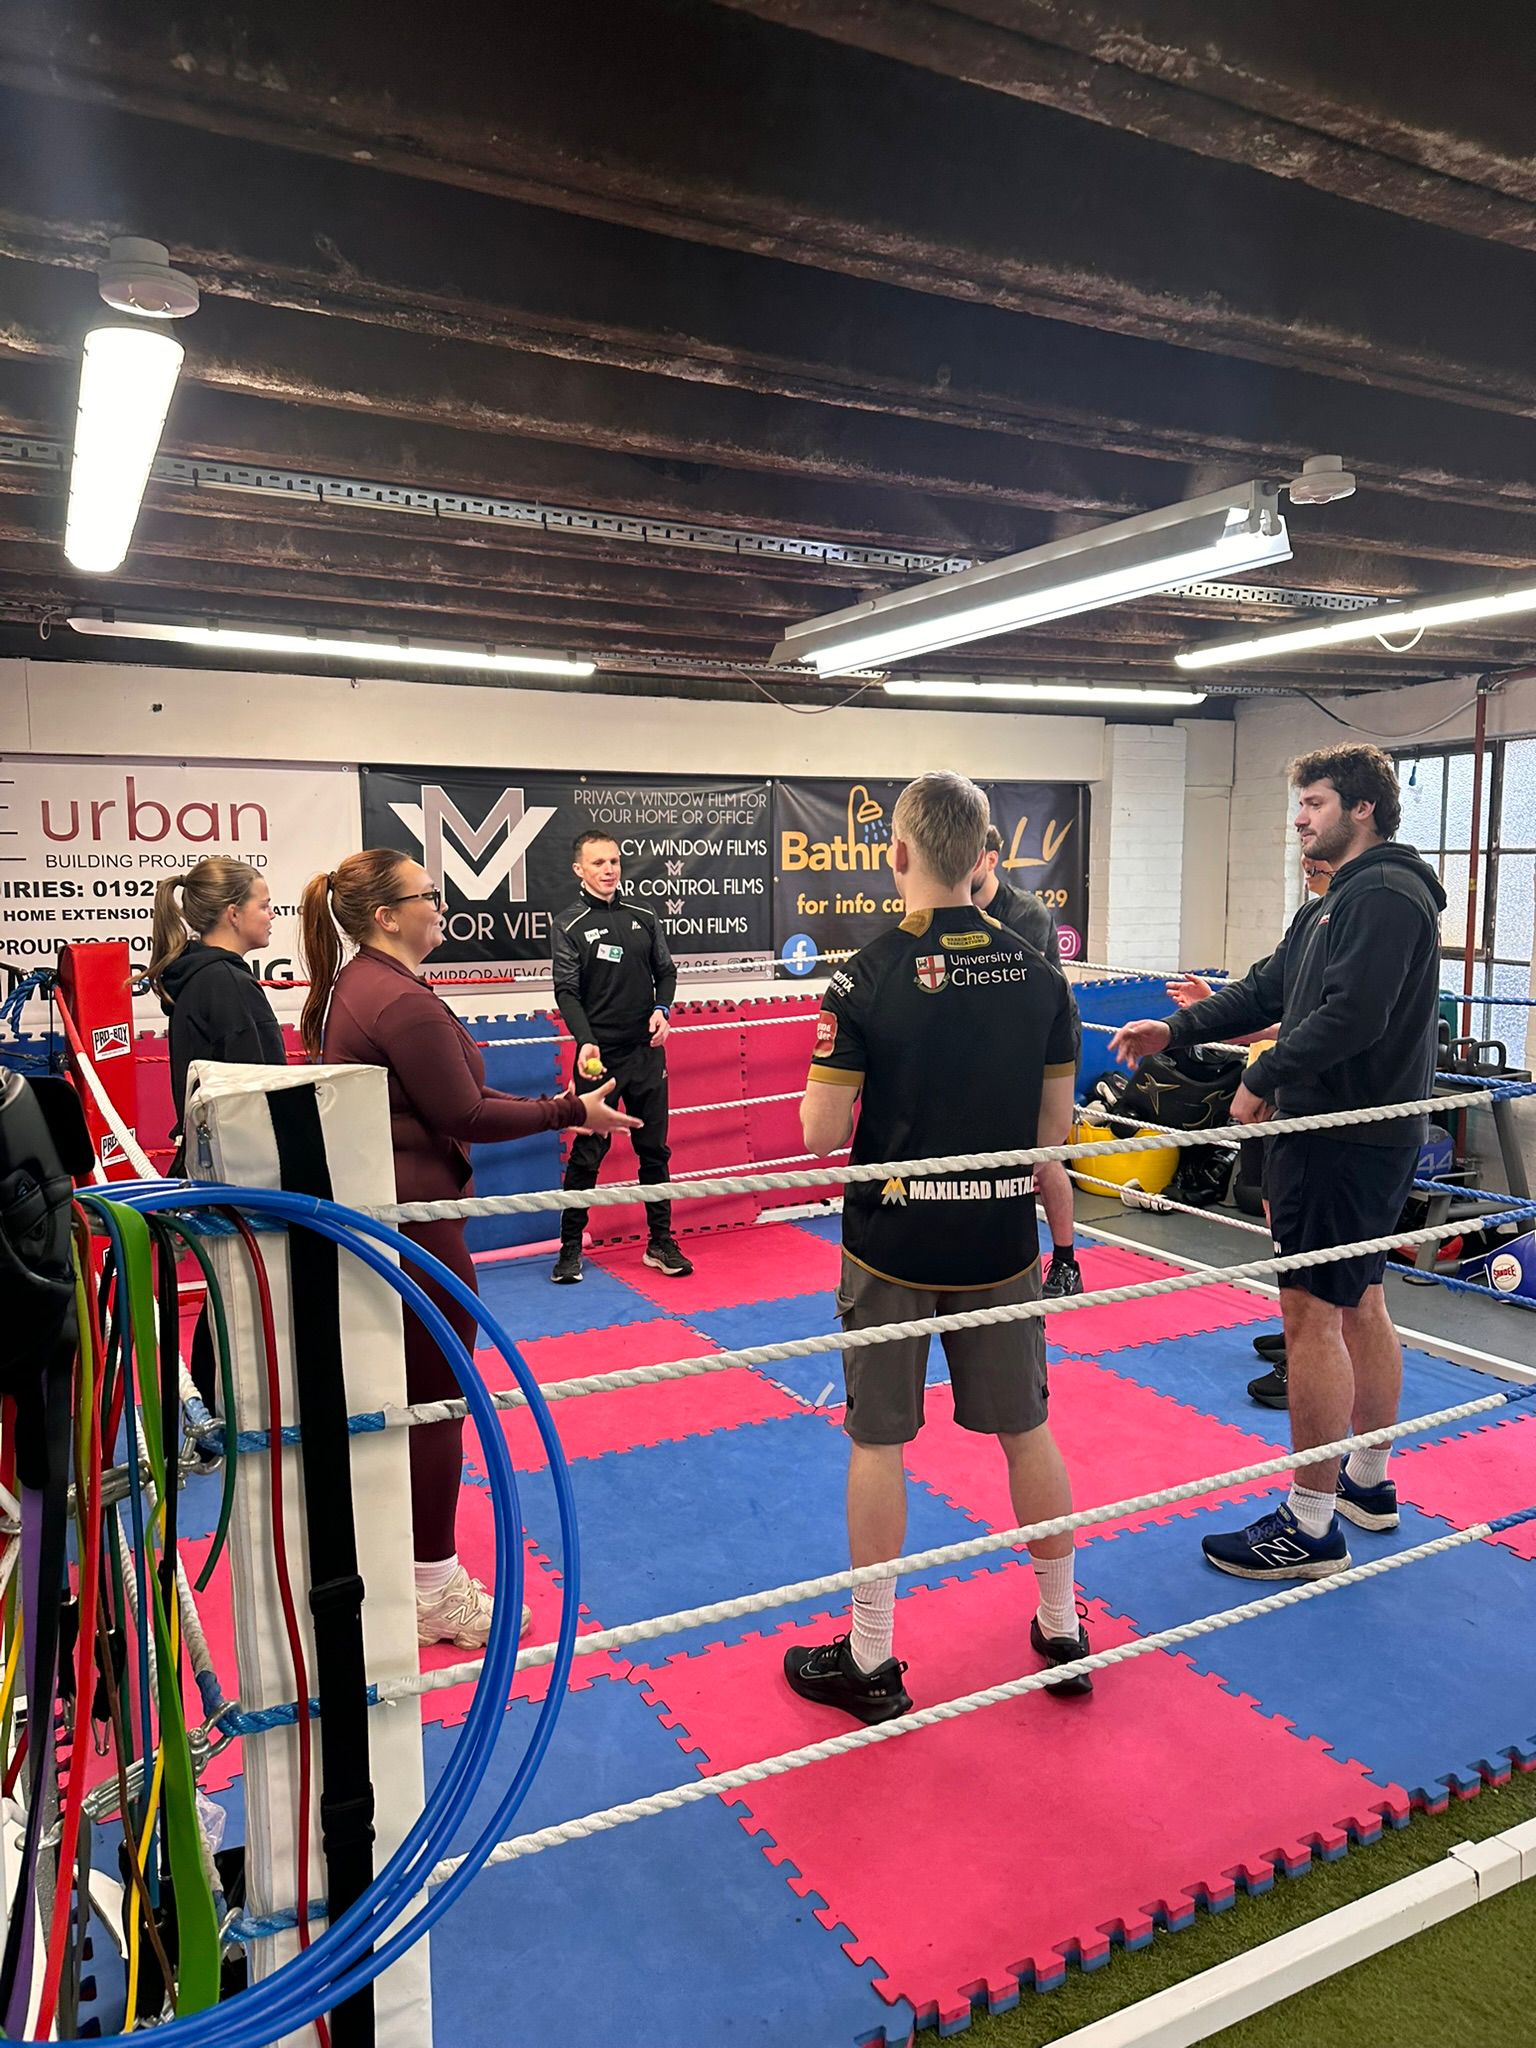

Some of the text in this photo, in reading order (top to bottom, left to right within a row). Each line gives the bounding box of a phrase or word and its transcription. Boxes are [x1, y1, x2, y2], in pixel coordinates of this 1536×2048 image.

[574, 790, 767, 808] PRIVACY WINDOW FILM FOR
[41, 776, 268, 842] urban
[589, 808, 754, 825] YOUR HOME OR OFFICE
[650, 840, 724, 856] WINDOW
[726, 840, 768, 856] FILMS
[46, 854, 133, 868] BUILDING
[0, 880, 162, 898] IRIES: 0192
[639, 879, 720, 896] CONTROL
[723, 878, 765, 895] FILMS
[797, 893, 829, 915] for
[835, 892, 875, 914] info
[3, 909, 56, 922] HOME
[503, 912, 554, 940] VIE
[659, 917, 748, 935] TION FILMS
[949, 951, 1024, 966] University of
[951, 967, 1028, 986] Chester
[94, 1026, 128, 1050] PRO-BOX
[909, 1180, 991, 1200] MAXILEAD
